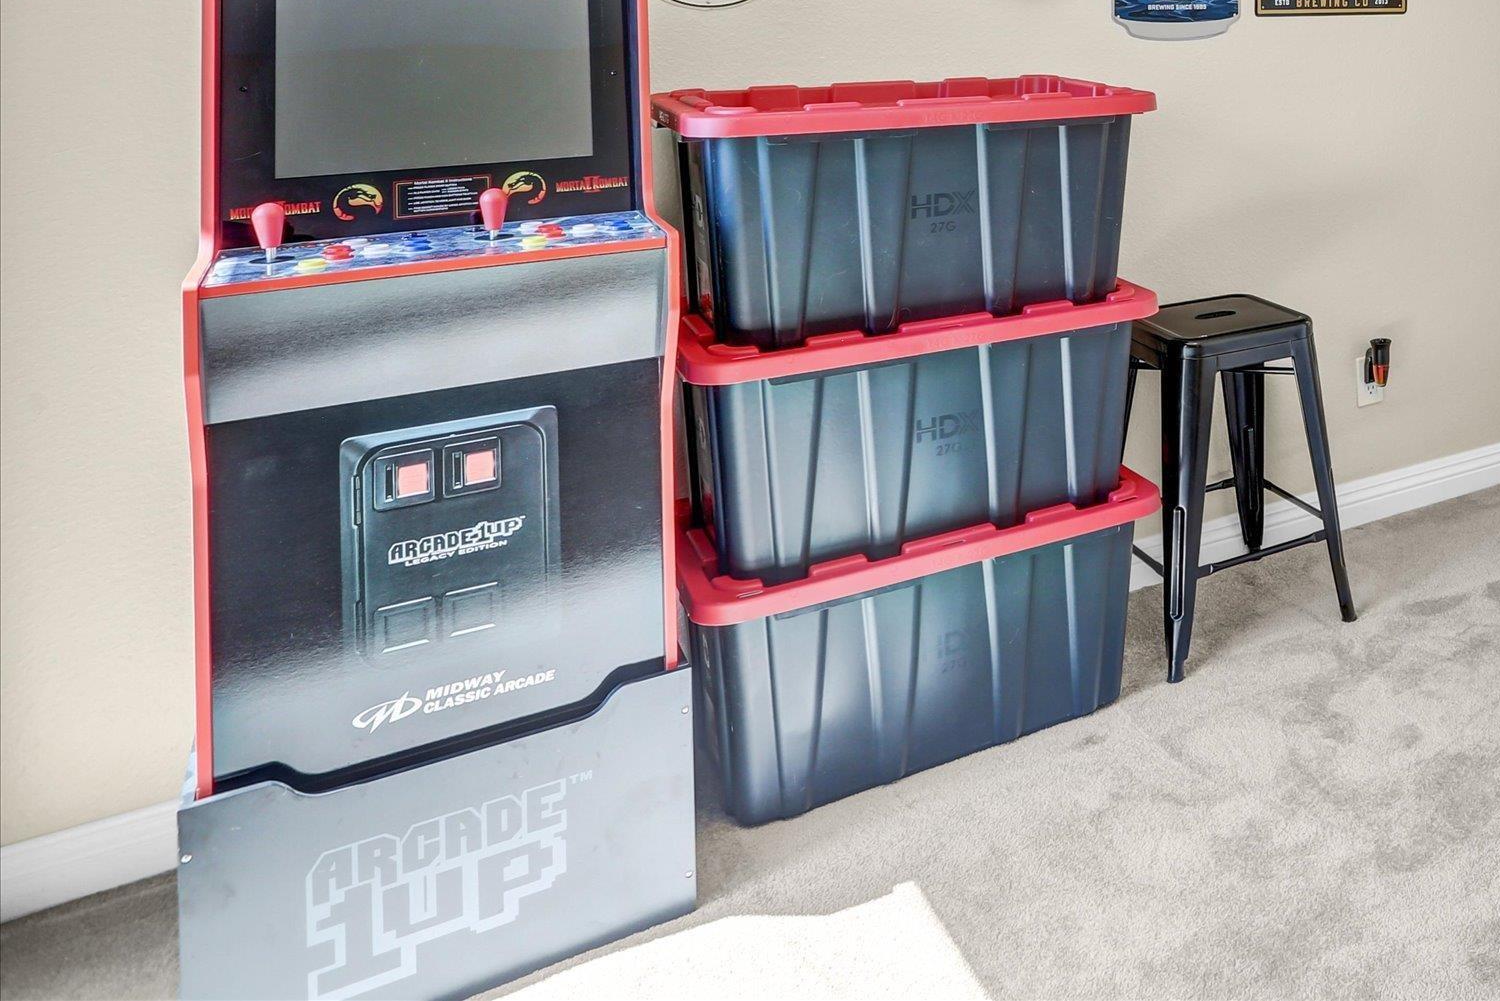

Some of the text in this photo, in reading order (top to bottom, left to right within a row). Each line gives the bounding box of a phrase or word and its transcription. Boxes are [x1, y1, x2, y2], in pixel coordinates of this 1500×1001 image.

[283, 201, 321, 216] OMBAT
[911, 189, 976, 219] HDX
[930, 221, 957, 233] 27G
[916, 408, 981, 443] HDX
[405, 539, 507, 567] LEGACY EDITION
[423, 668, 556, 714] CLASSIC ARCADE
[425, 669, 507, 700] MIDWAY
[306, 778, 567, 910] ARCADE
[307, 834, 567, 1001] 1UP
